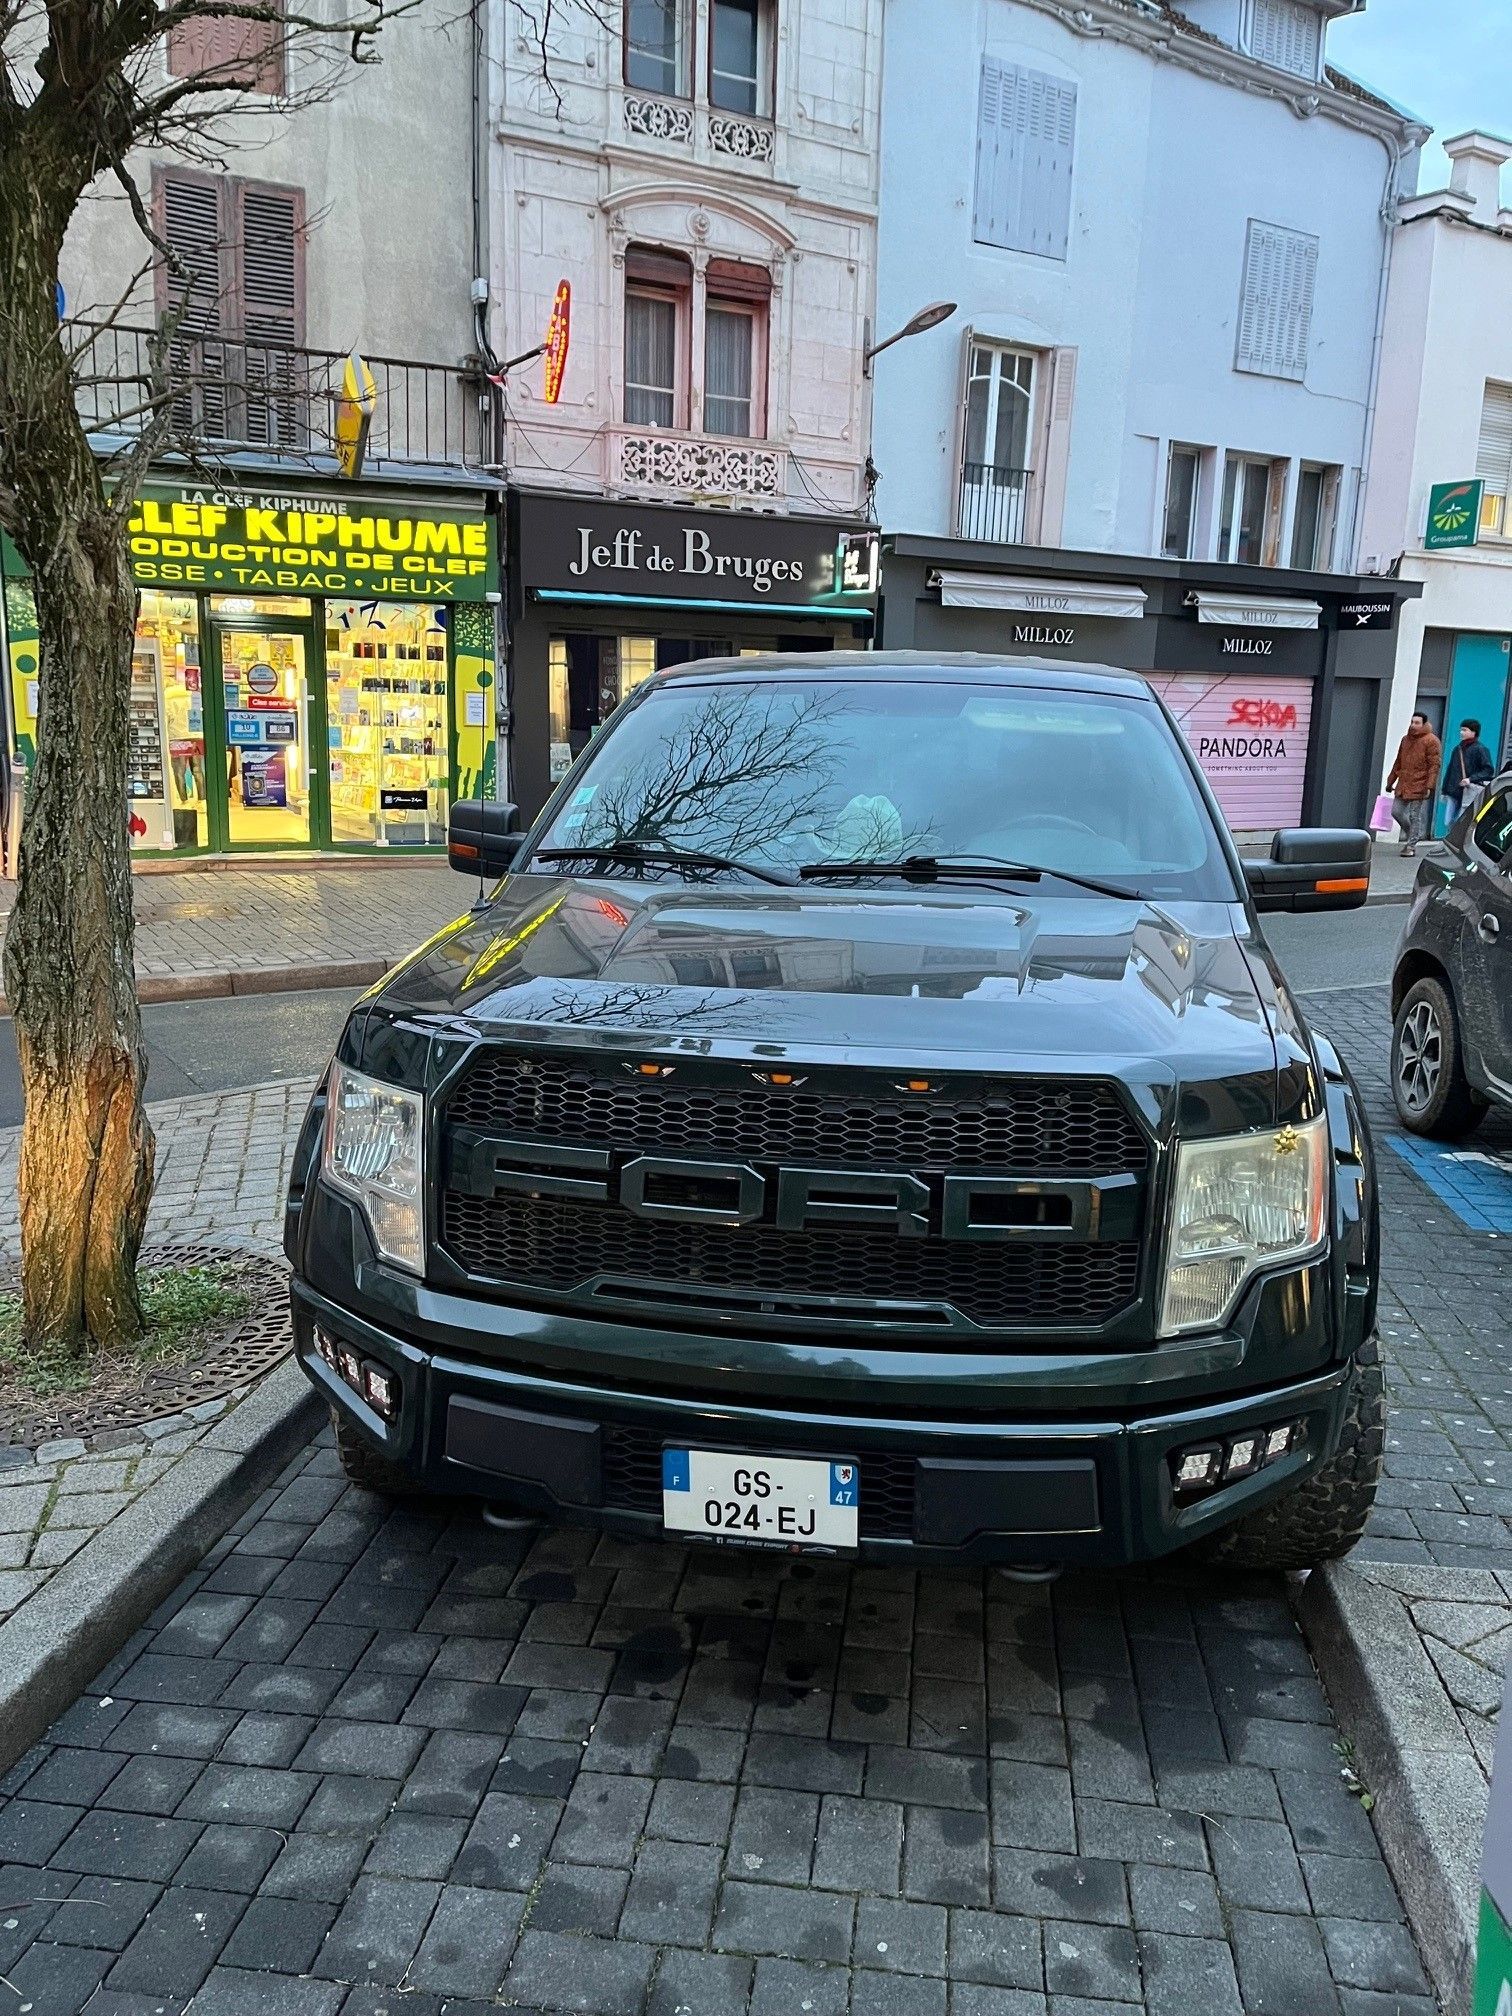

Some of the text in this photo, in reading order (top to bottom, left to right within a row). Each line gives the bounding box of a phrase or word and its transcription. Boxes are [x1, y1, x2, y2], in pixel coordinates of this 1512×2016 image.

[181, 490, 347, 515] LA CLEF KIPHUME
[245, 508, 487, 556] KIPHUME
[1431, 535, 1468, 543] Groupama
[130, 537, 487, 575] ODUCTION DE CLEF
[569, 528, 643, 575] Jeff
[646, 546, 675, 572] de
[679, 529, 803, 593] Bruges
[134, 562, 454, 596] SSE TABAC JEUX
[1025, 596, 1071, 610] MILLOZ
[1341, 604, 1391, 613] MAUBOUSSIN
[1241, 610, 1279, 624] MILLOZ
[1014, 626, 1075, 644] MILLOZ
[1222, 638, 1273, 655] MILLOZ
[1199, 737, 1287, 758] PANDORA
[468, 1136, 1103, 1240] FORD
[673, 1475, 680, 1486] F
[733, 1469, 784, 1498] GS-
[835, 1491, 852, 1504] 47
[704, 1500, 816, 1536] 024-EJ
